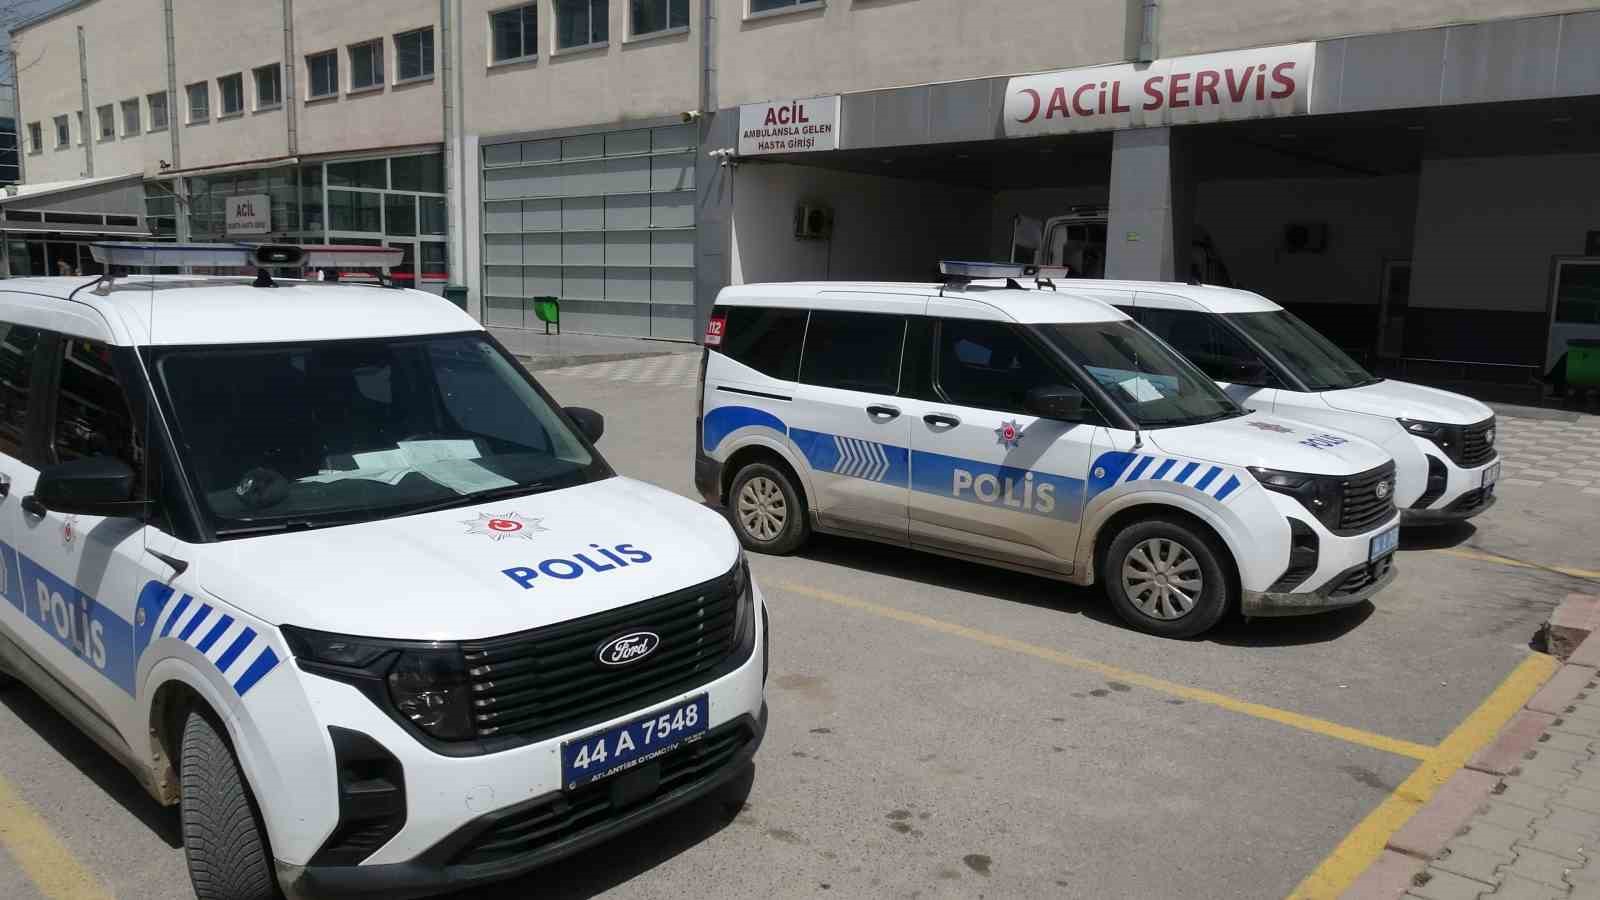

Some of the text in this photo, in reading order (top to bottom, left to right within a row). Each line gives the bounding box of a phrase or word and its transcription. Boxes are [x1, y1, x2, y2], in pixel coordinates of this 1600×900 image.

[764, 101, 809, 126] ACİL
[743, 124, 832, 139] AMBULANSLA GELEN
[758, 140, 786, 151] HASTA
[501, 543, 653, 590] POLİS
[611, 637, 648, 662] Ford
[573, 738, 608, 769] 44
[614, 730, 636, 757] A
[642, 703, 698, 745] 7548
